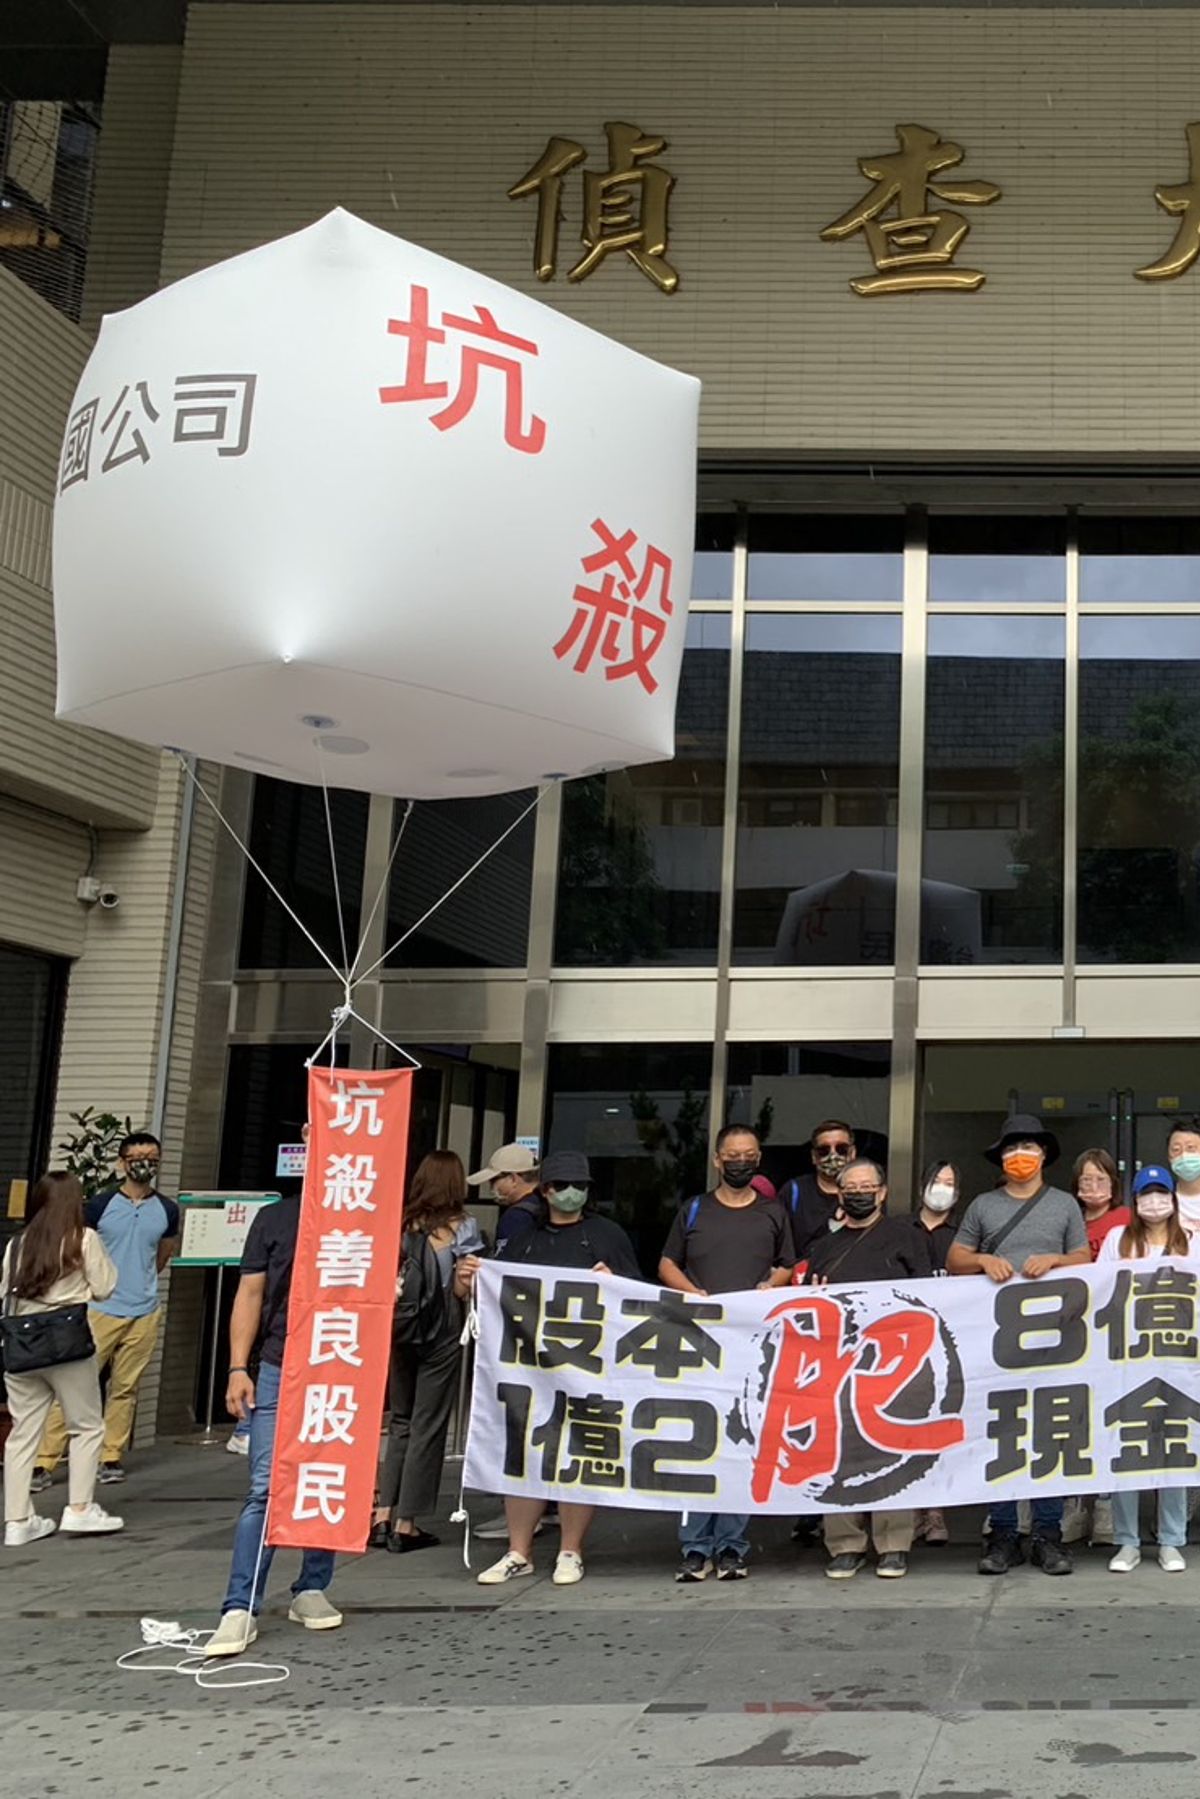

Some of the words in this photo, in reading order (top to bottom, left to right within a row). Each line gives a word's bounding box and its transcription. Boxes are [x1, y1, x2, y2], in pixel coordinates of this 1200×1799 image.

[291, 1080, 384, 1525] 坑殺善良股民
[499, 1275, 723, 1378] 股本
[992, 1266, 1199, 1369] 8億
[497, 1383, 718, 1494] 1億2
[750, 1297, 964, 1504] 肥
